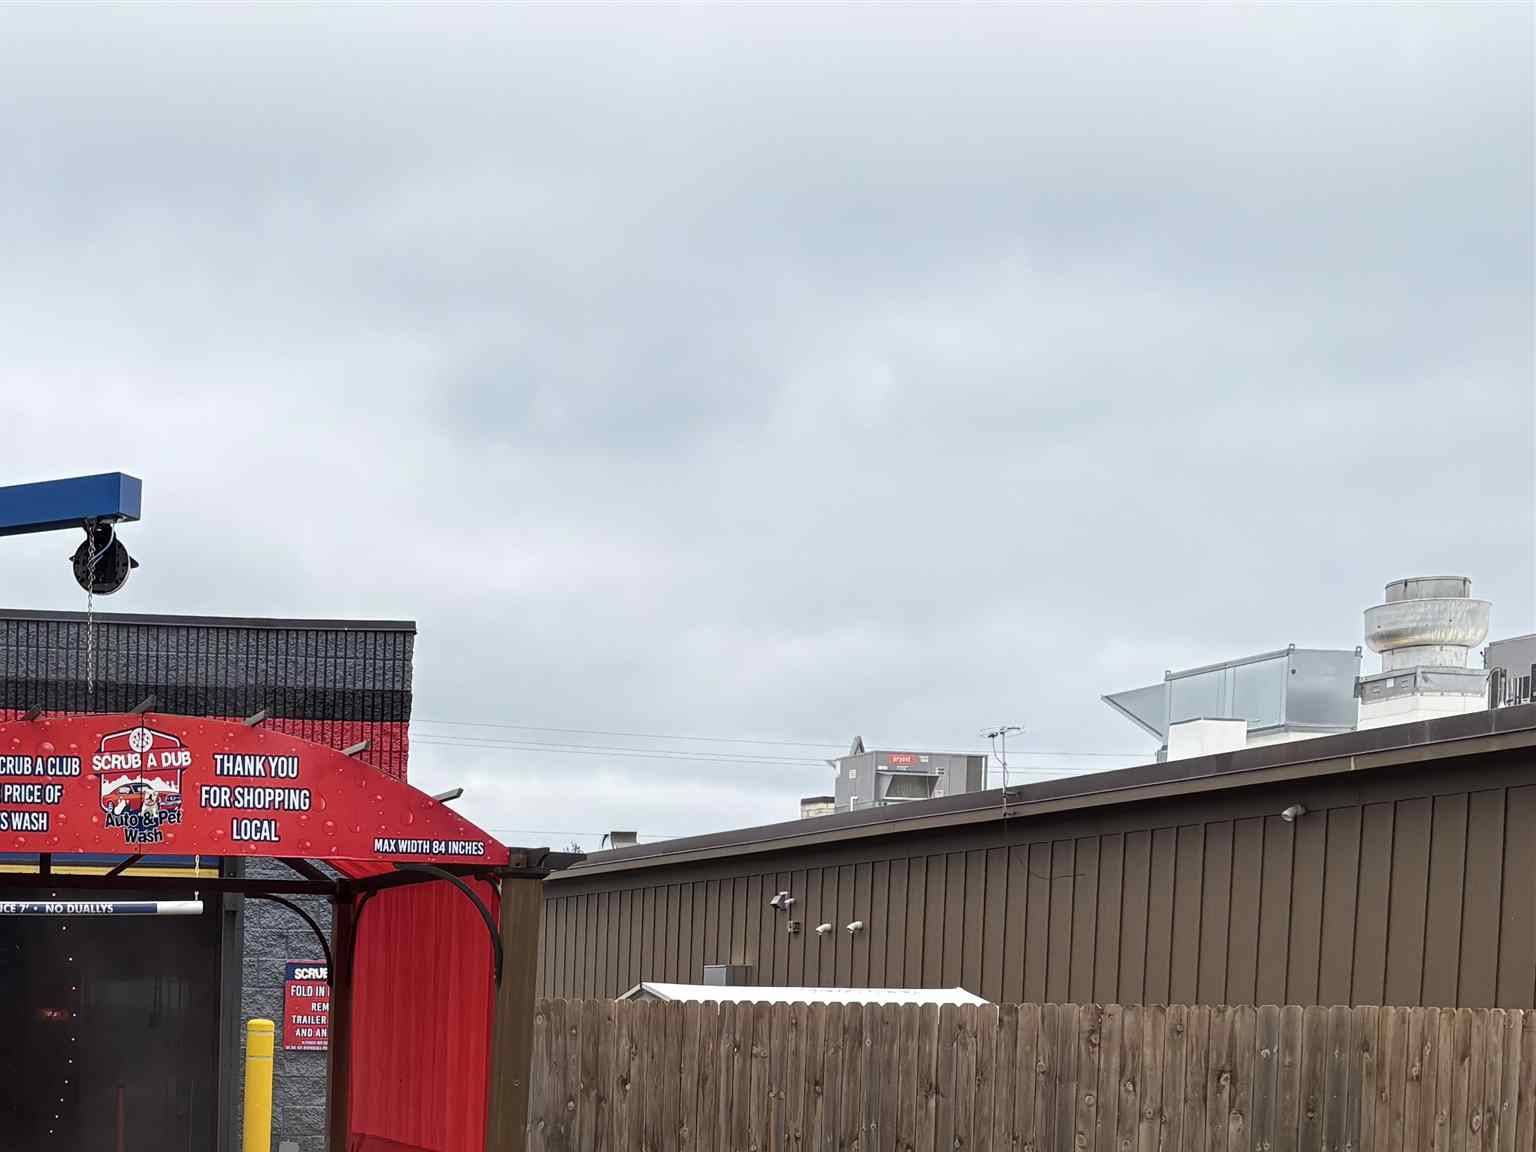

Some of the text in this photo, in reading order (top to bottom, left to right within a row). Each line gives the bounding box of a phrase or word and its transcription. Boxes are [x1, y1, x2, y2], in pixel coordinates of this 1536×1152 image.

[35, 757, 44, 775] A
[47, 757, 80, 776] CLUB
[92, 751, 192, 771] SCRUB A DUB
[214, 754, 298, 778] THANK YOU
[4, 784, 41, 803] PRICE
[45, 785, 62, 803] OF
[200, 786, 310, 810] FOR SHOPPING
[11, 812, 48, 831] WASH
[105, 808, 183, 827] Auto & Pet
[124, 828, 163, 843] Wash
[232, 819, 279, 841] LOCAL
[374, 838, 484, 855] MAX WIDTH 84 INCHES
[45, 903, 63, 914] NO
[66, 904, 114, 914] DUALLYS
[291, 985, 325, 997] FOLD IN
[292, 1015, 327, 1024] TRAILER
[296, 1028, 327, 1037] AND AN
